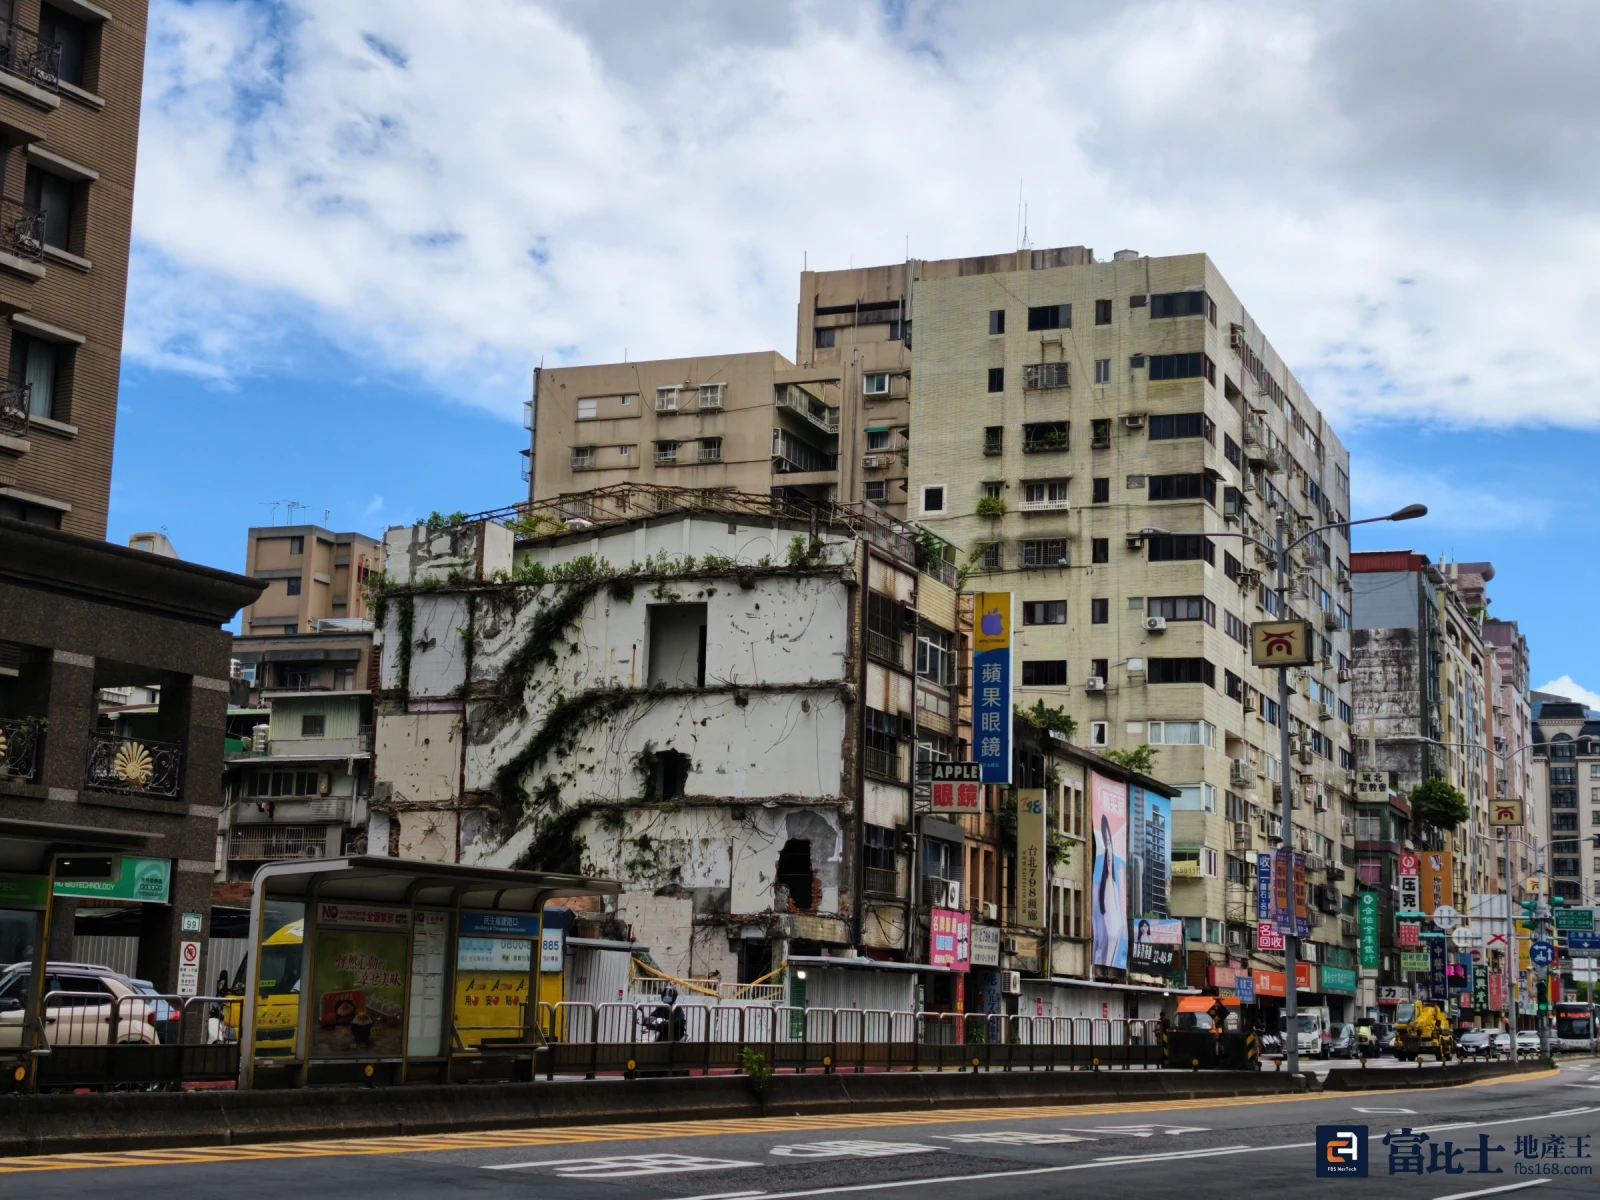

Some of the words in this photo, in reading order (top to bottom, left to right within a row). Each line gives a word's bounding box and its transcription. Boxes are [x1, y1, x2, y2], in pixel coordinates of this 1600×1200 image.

[981, 663, 1002, 758] 蘋果眼鏡
[935, 765, 978, 779] APPLE
[933, 783, 978, 808] 眼鏡
[1020, 797, 1042, 814] 798
[187, 920, 197, 929] 99
[1260, 936, 1282, 948] 回收
[336, 954, 386, 971] 怦然心動的
[486, 996, 493, 1006] 安
